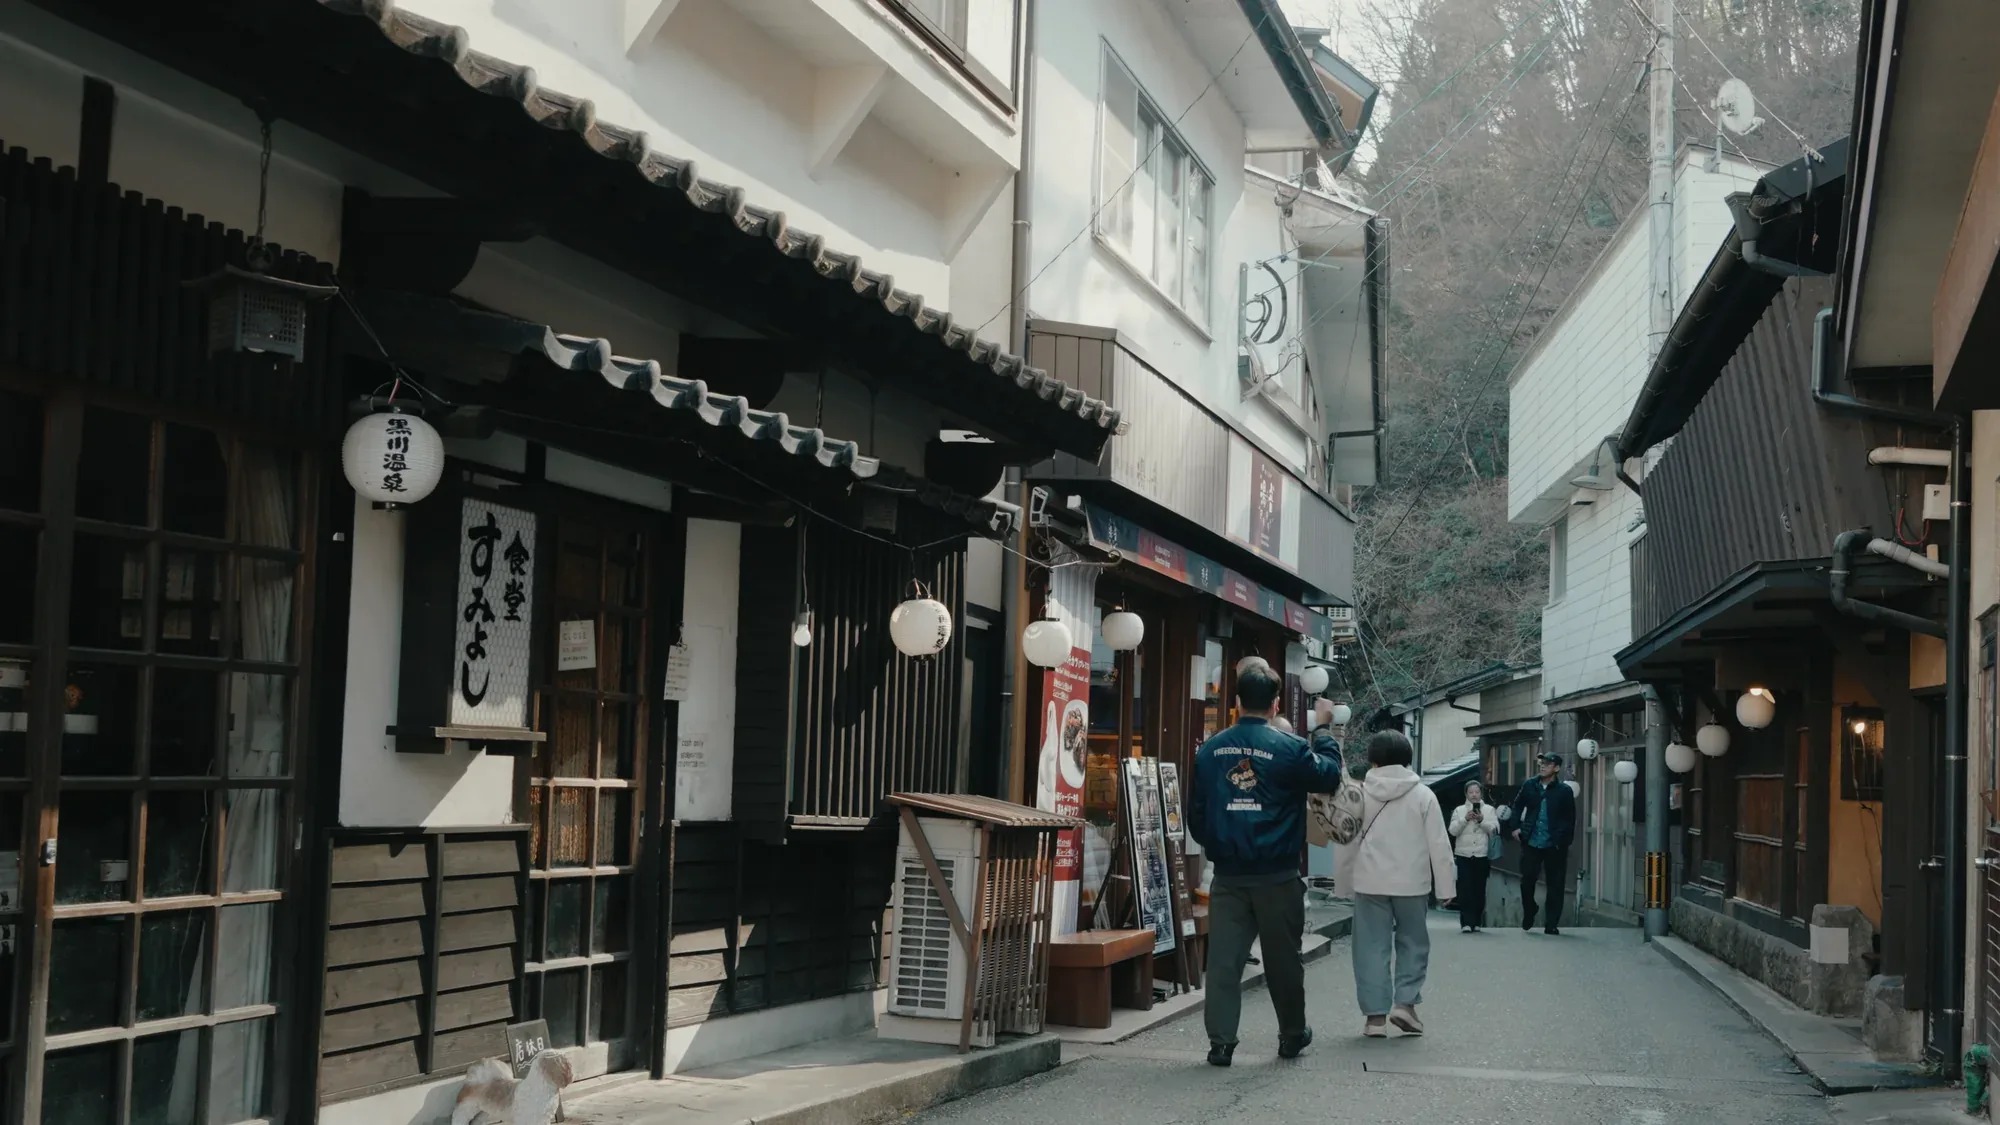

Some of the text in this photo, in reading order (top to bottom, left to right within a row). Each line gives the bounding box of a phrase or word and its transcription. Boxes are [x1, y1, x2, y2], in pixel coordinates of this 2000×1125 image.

[381, 418, 412, 493] 黒川温泉
[503, 531, 530, 622] 食堂
[461, 511, 501, 708] すみよし
[1213, 746, 1242, 757] FREEDOM
[1242, 747, 1252, 756] TO
[1252, 749, 1274, 760] ROAM
[1226, 803, 1262, 811] AMERICAN
[515, 1036, 545, 1064] 店休日
